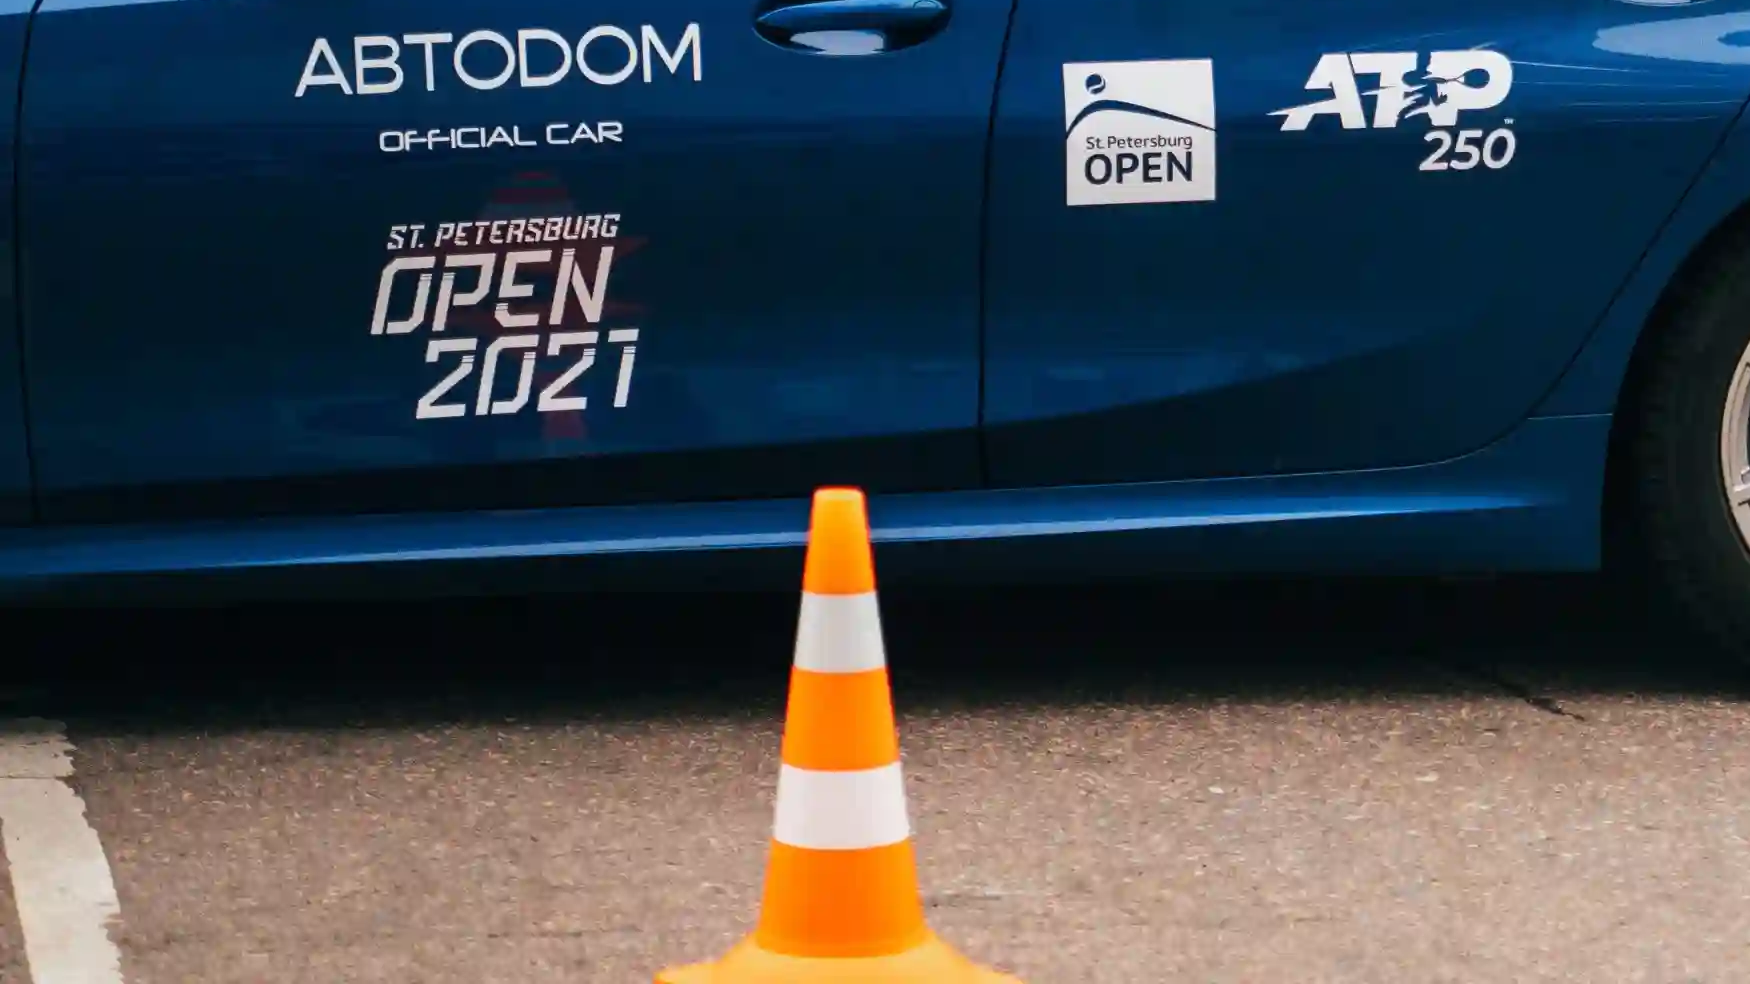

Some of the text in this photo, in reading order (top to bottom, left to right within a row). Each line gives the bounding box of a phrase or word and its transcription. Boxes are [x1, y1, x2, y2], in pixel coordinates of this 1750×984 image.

[1266, 49, 1514, 131] ATP
[379, 121, 624, 152] OFFICIAL CAR
[1107, 135, 1193, 150] Petersburg
[1419, 128, 1516, 171] 250
[1084, 151, 1193, 185] OPEN
[387, 213, 621, 250] ST. PETERSBURG
[370, 245, 615, 335] OPEN
[416, 328, 640, 420] 2021
